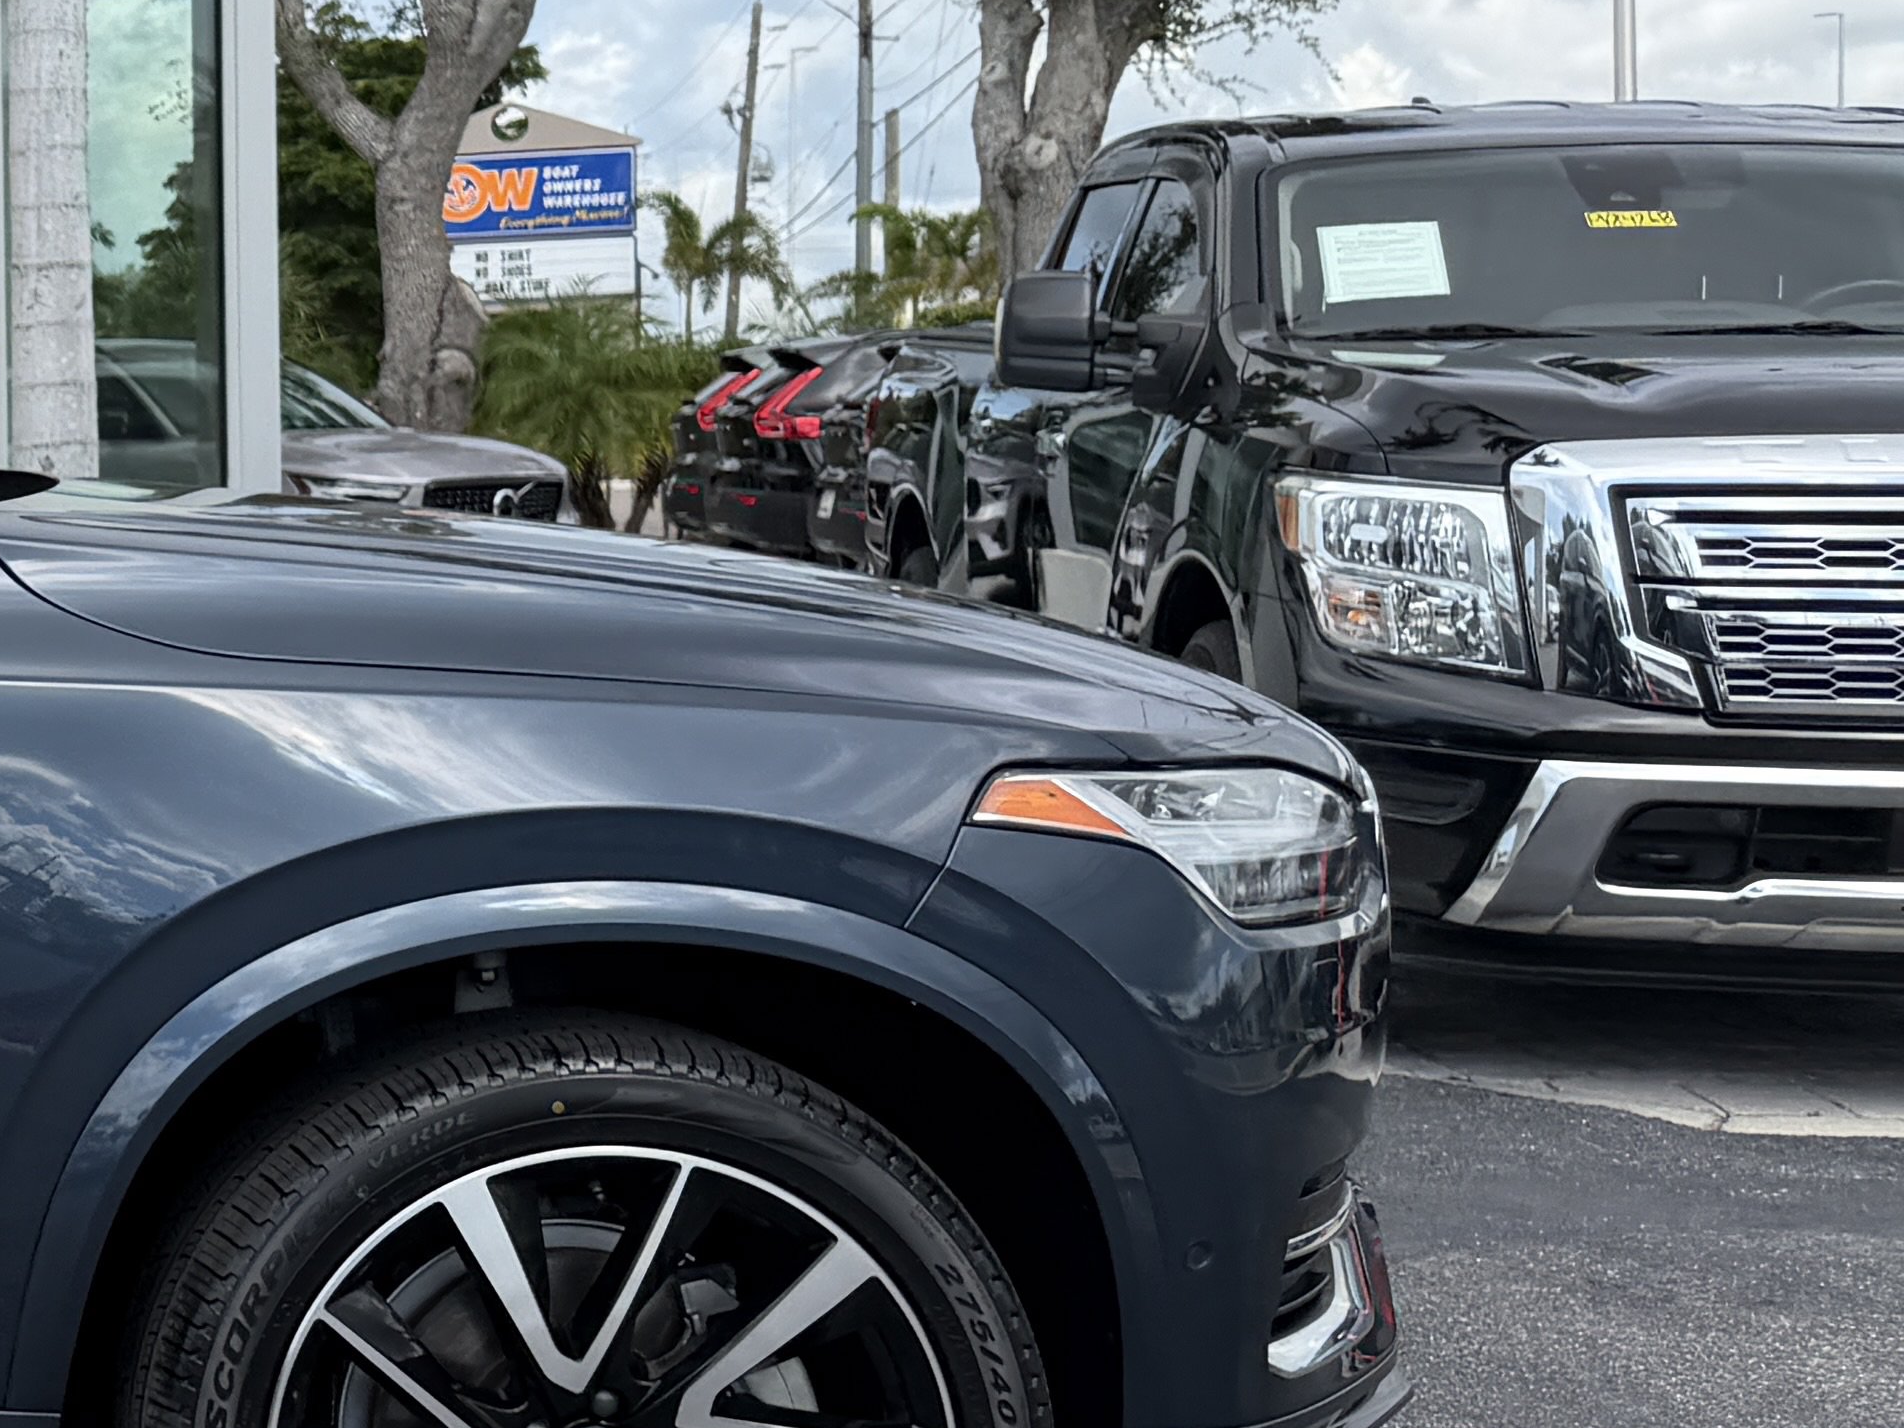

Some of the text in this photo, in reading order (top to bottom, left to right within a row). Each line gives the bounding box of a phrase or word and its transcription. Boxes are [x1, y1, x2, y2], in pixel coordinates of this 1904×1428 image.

[543, 166, 579, 179] BOAT
[543, 179, 601, 194] OWNERS
[543, 192, 625, 209] WAREHOUSE
[474, 250, 488, 262] NO
[474, 267, 488, 279] NO
[934, 1262, 1018, 1425] 275/40
